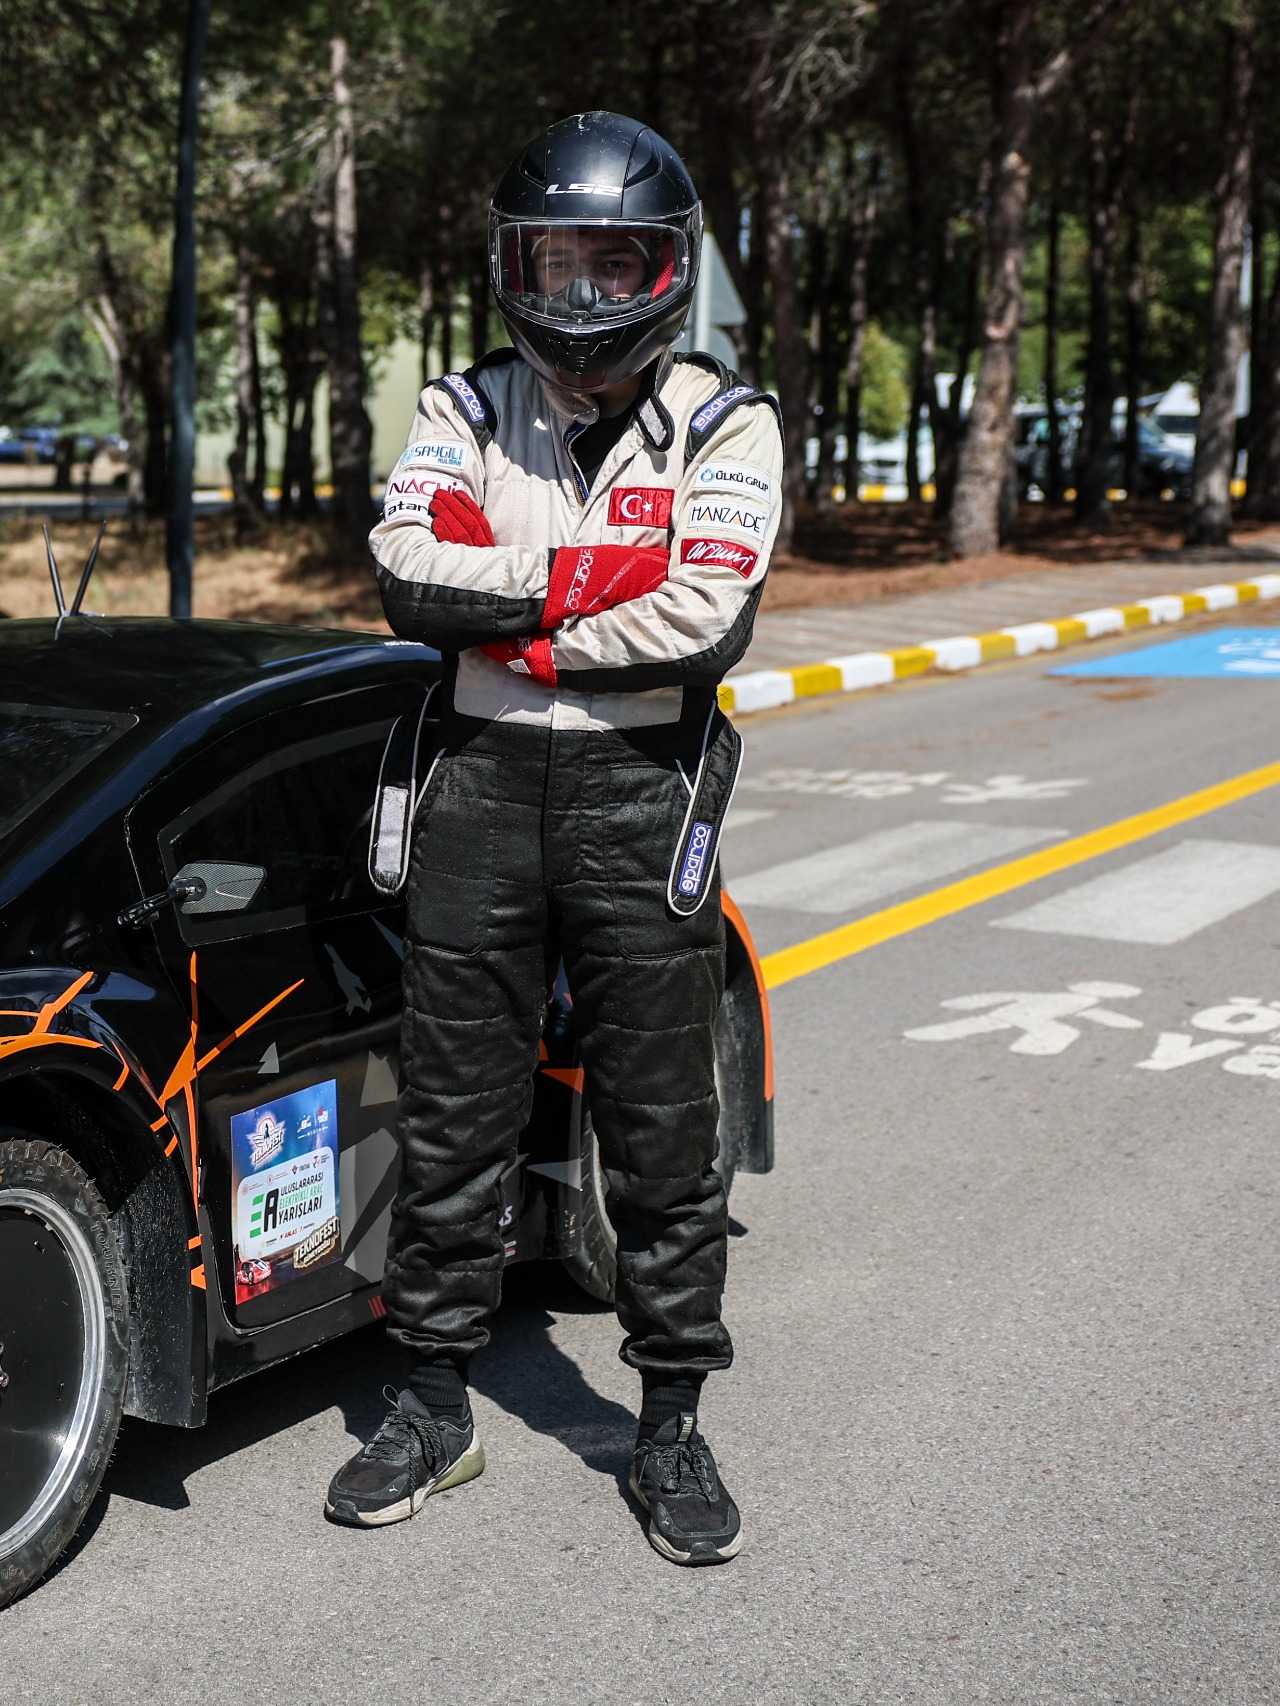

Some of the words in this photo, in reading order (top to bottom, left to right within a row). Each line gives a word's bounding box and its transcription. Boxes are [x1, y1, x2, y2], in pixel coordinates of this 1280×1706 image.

[545, 183, 623, 198] LS2
[449, 374, 485, 418] sparco
[692, 386, 749, 428] sparco
[414, 445, 464, 460] SAYGILI
[715, 470, 744, 483] ÜLKÜ
[745, 476, 769, 492] GRUP
[691, 506, 763, 534] HANZADE
[565, 548, 595, 610] sparco
[682, 826, 710, 892] sparco
[280, 1172, 324, 1196] ULUSLARARASI
[279, 1189, 309, 1210] ELEKTRİKLİ
[279, 1195, 323, 1225] YARIŞLARI
[295, 1220, 337, 1261] TEKNOFEST
